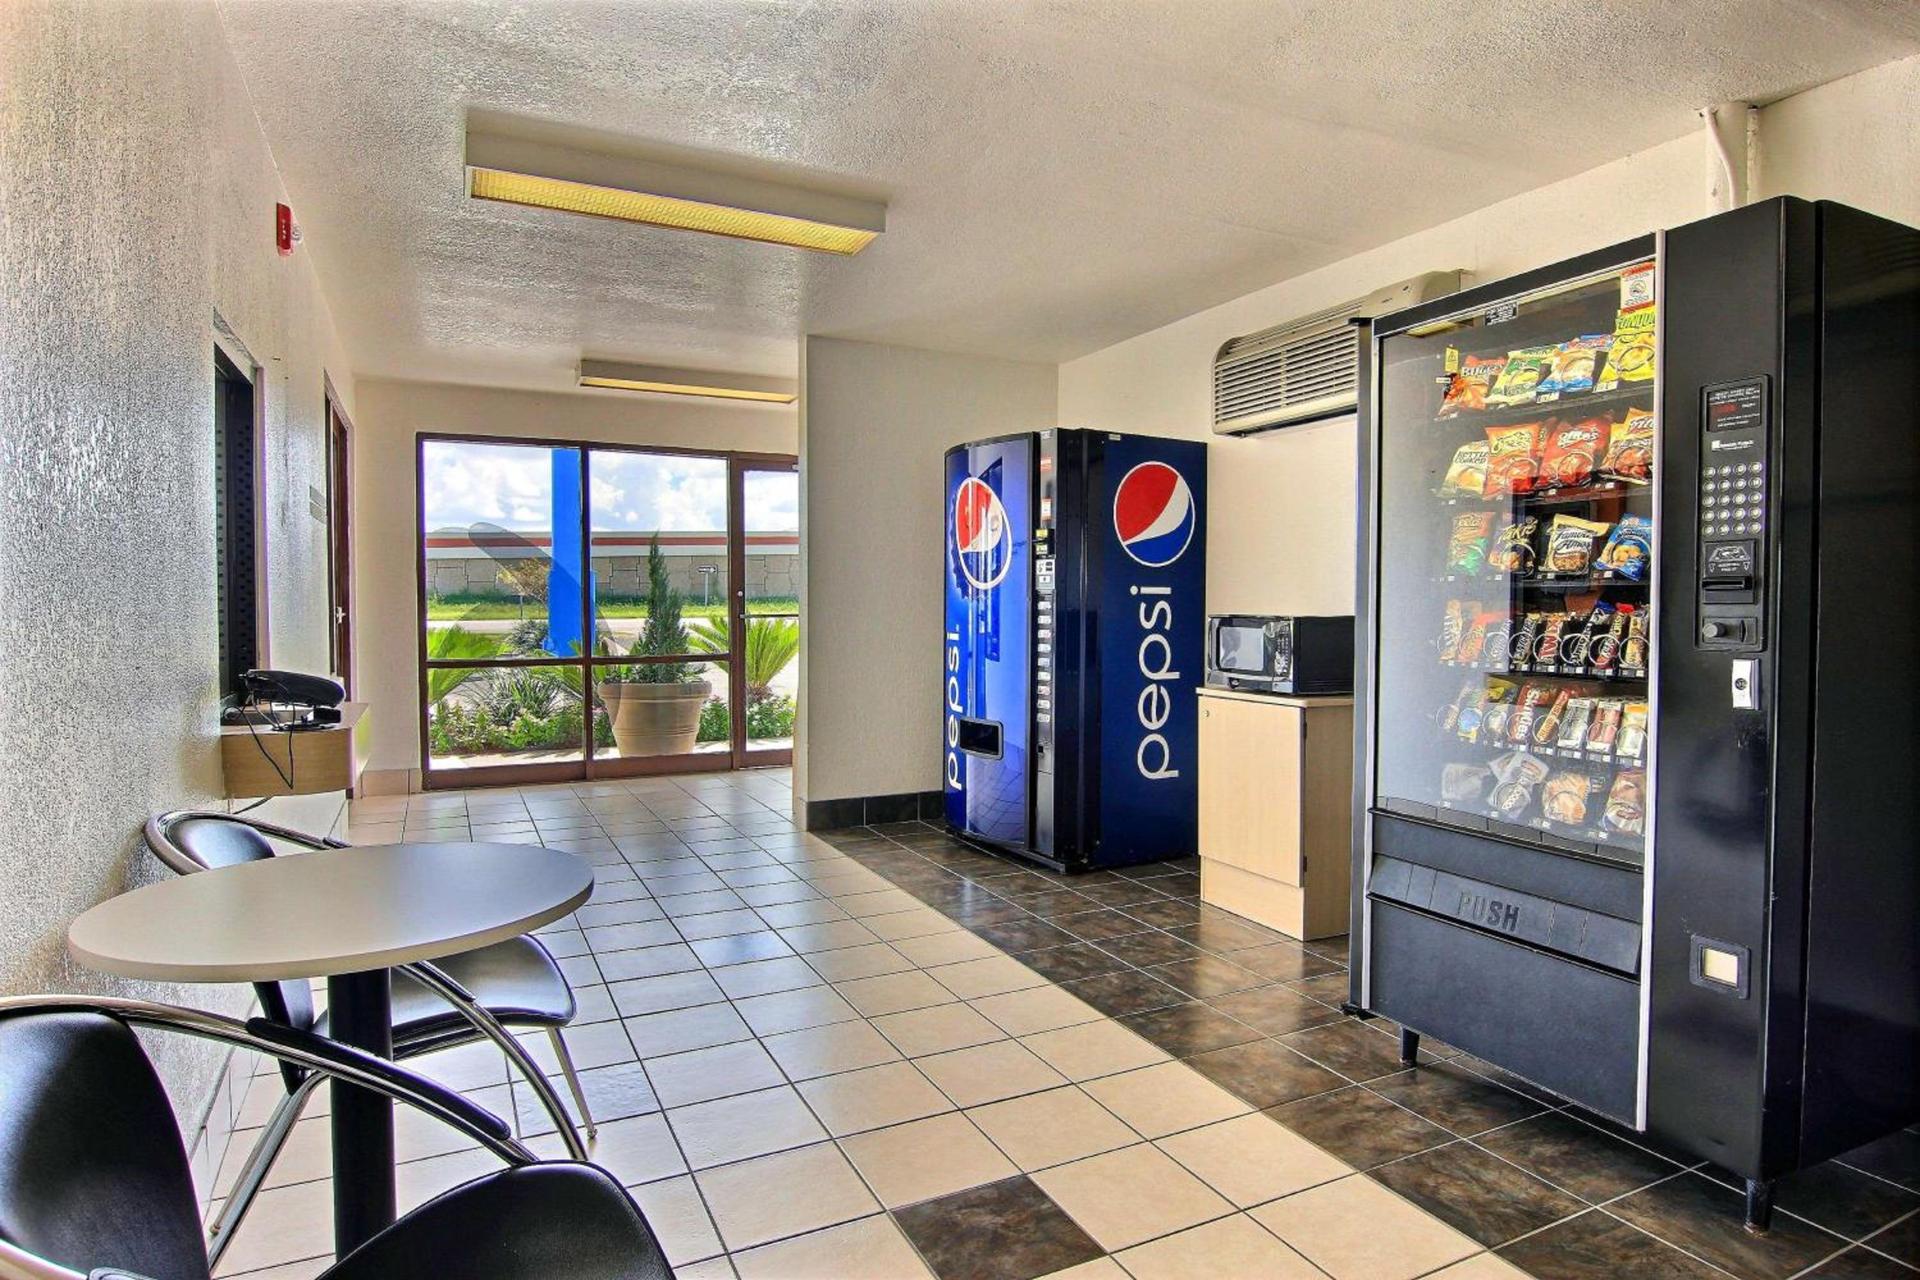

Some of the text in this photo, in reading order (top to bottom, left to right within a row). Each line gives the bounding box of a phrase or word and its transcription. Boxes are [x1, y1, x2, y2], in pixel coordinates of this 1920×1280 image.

[946, 632, 963, 791] pepsi
[1130, 585, 1180, 780] pepsi
[1457, 891, 1520, 932] PUSH
